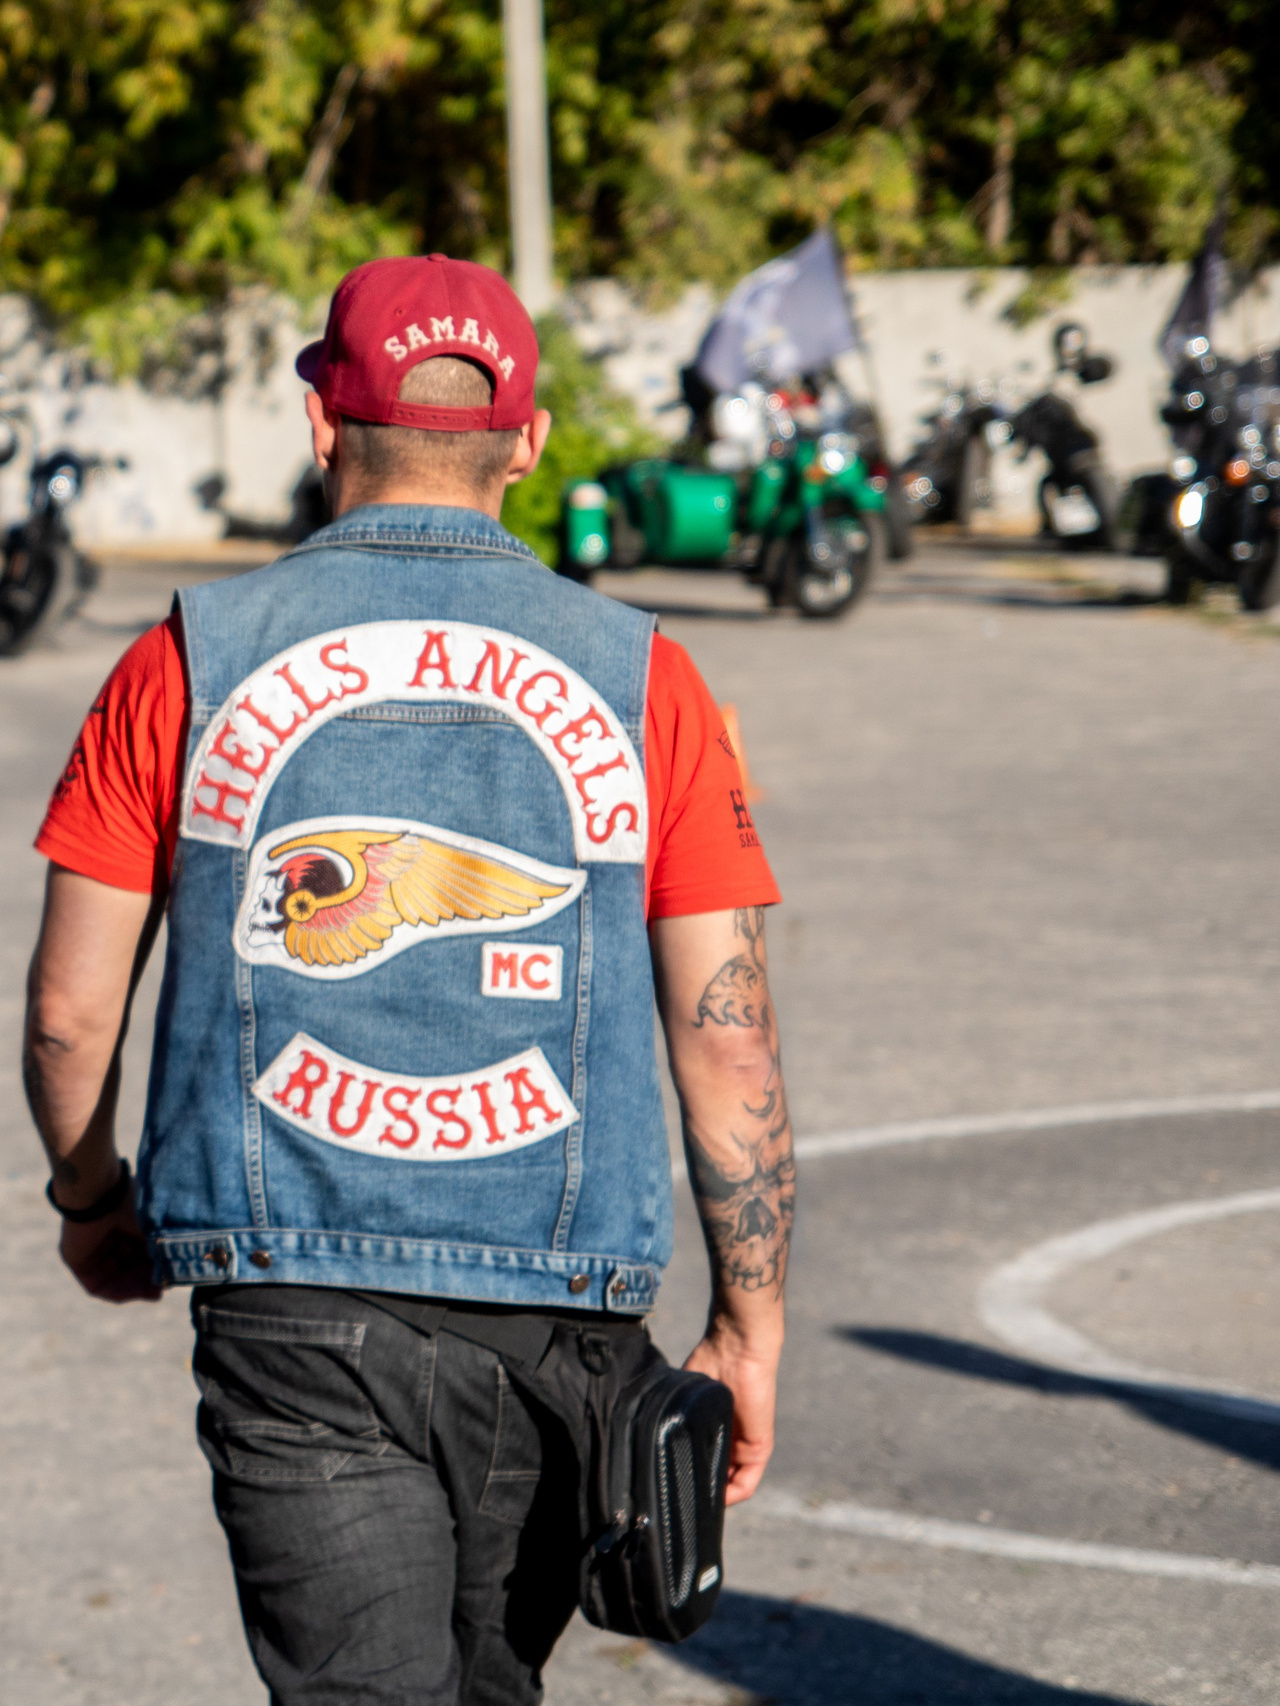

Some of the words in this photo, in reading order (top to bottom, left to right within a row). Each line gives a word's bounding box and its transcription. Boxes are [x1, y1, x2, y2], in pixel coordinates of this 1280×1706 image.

[384, 316, 515, 381] SAMARA
[192, 638, 370, 834] HELLS
[407, 630, 638, 844] ANGELS
[491, 952, 552, 990] MC
[273, 1049, 562, 1151] RUSSIA
